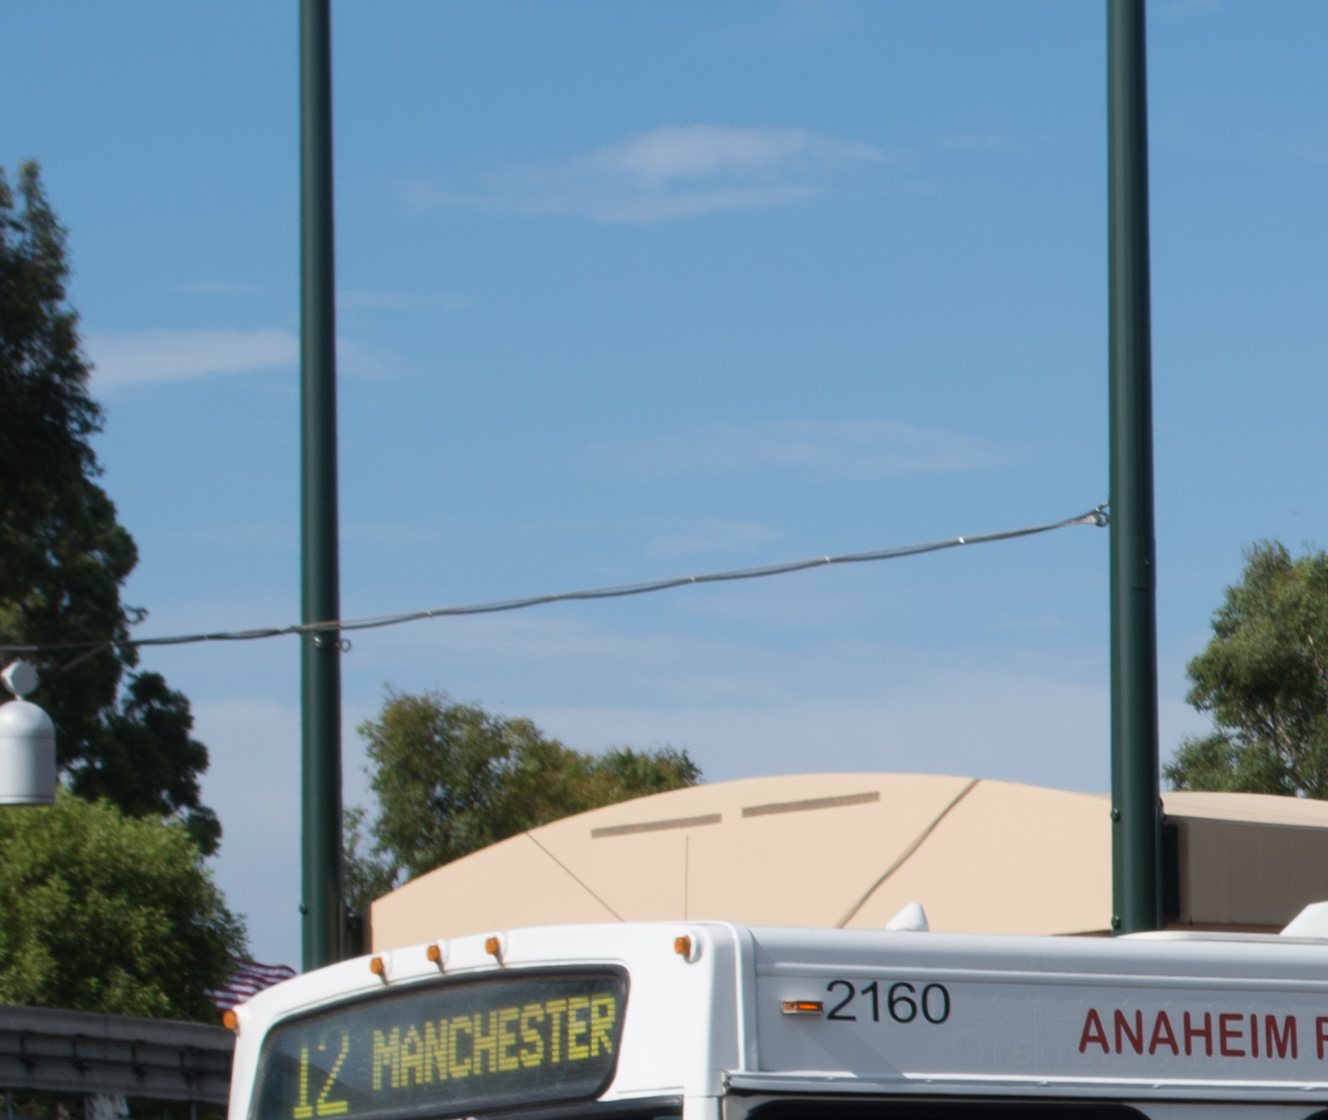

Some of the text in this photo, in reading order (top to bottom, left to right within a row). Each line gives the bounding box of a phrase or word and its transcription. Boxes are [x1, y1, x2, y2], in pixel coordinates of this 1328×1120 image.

[825, 979, 951, 1025] 2160
[293, 994, 616, 1119] 12 MANCHESTER
[1078, 1008, 1299, 1060] ANAHEIM
